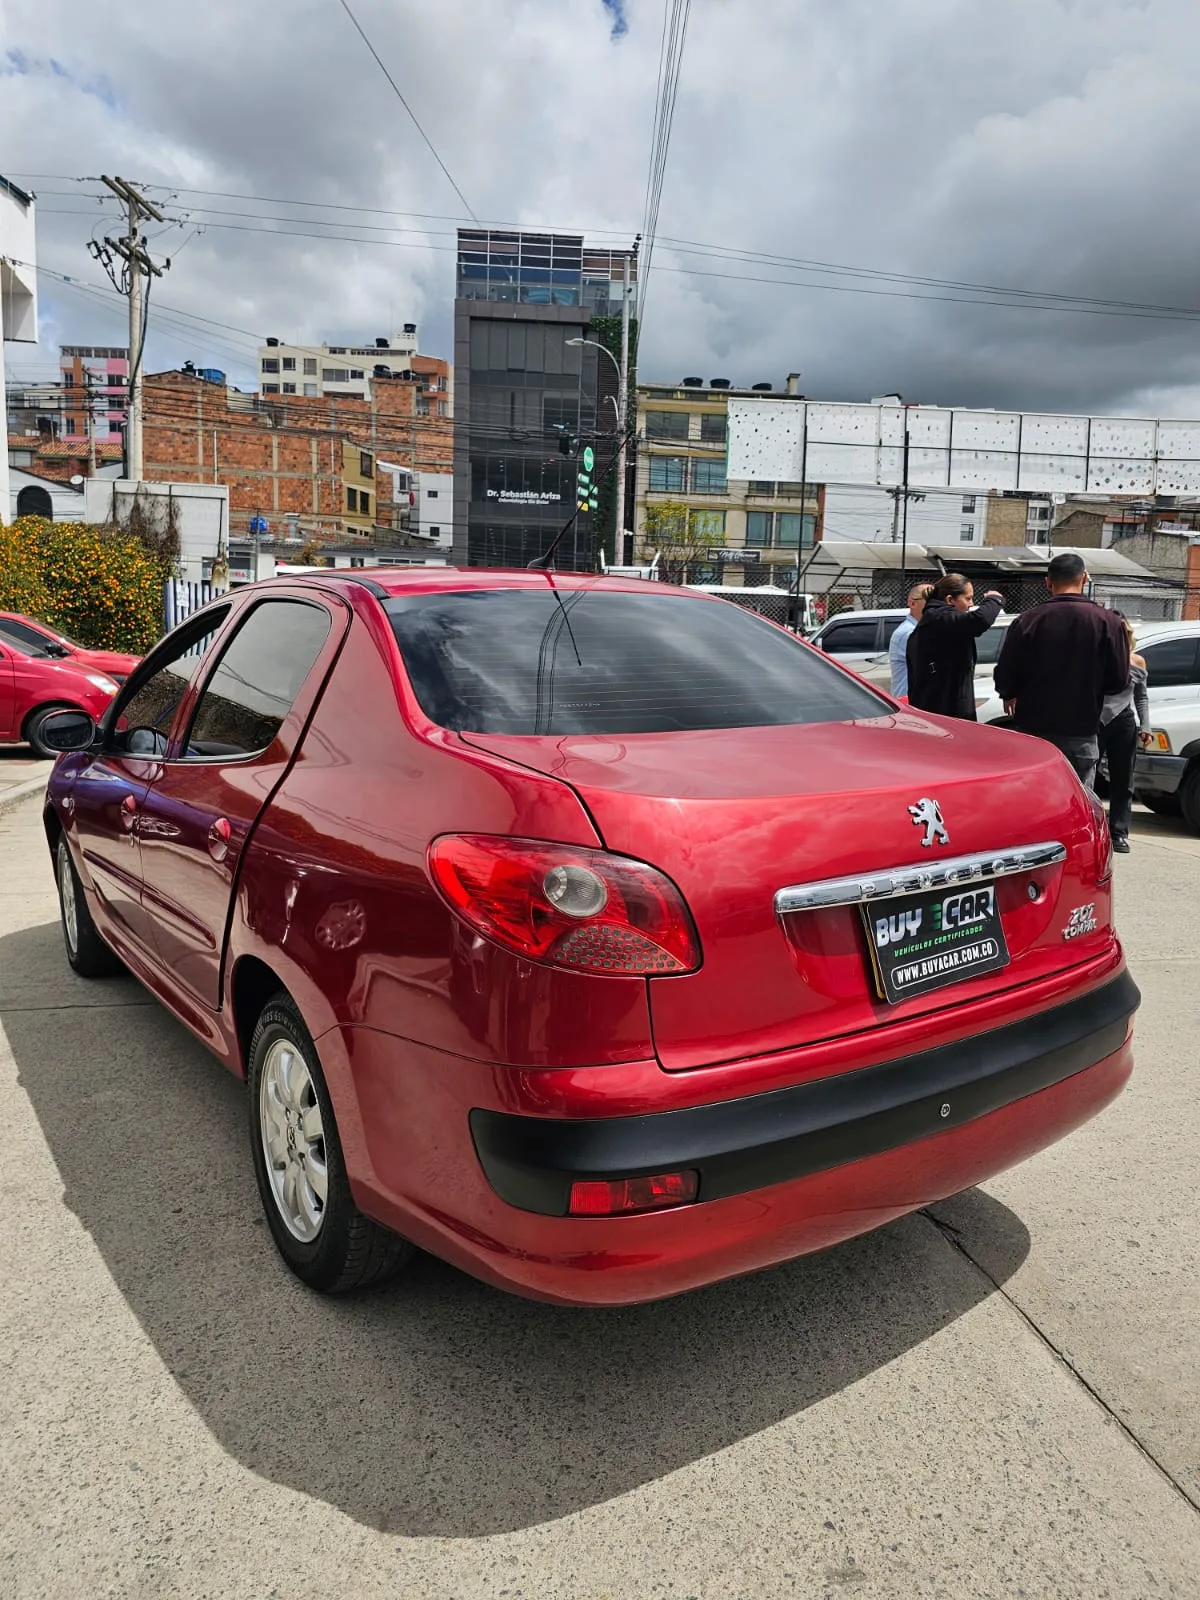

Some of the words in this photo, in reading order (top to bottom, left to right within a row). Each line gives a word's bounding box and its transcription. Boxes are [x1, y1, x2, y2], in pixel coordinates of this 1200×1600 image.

[487, 489, 499, 497] Dr.
[540, 492, 561, 500] Ariza
[860, 854, 1035, 899] PEUGEOT
[876, 907, 922, 948] BUY
[941, 885, 995, 931] CAR
[1069, 902, 1096, 926] 207
[934, 924, 983, 946] CERTIFICADOS
[896, 941, 993, 985] WWW.BUYACAR.COM.CO
